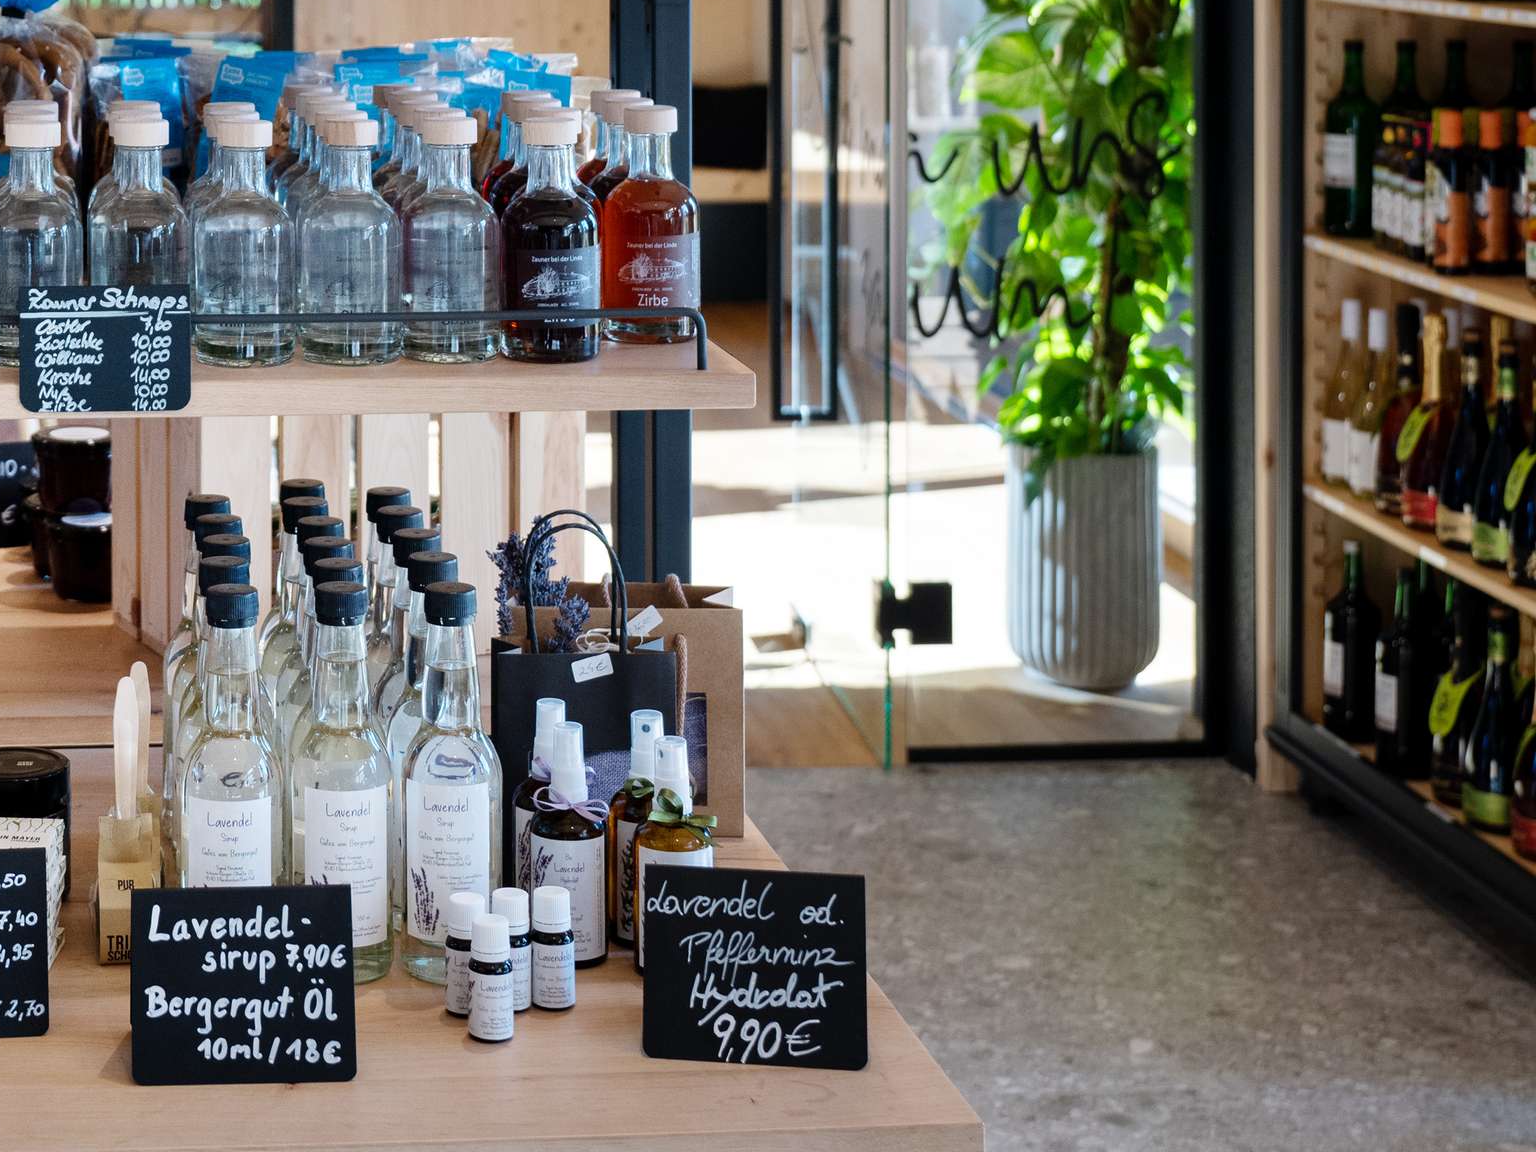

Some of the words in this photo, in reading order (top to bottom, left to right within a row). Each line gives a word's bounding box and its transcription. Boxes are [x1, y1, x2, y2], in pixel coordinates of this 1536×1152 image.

[28, 288, 97, 310] Zauner
[100, 285, 188, 321] Schnaps
[638, 294, 668, 306] Zirbe
[35, 319, 91, 335] Obstler
[140, 316, 172, 335] 7,00
[132, 333, 172, 352] 10,00
[35, 351, 104, 367] Williams
[130, 349, 170, 366] 10,00
[37, 367, 92, 386] Kirsche
[134, 384, 168, 398] 10,00
[38, 399, 92, 412] Zirbe
[326, 800, 371, 817] Lavendel
[423, 796, 468, 813] Lavendel
[207, 812, 253, 828] Lavendel
[554, 863, 585, 873] Lavendel
[117, 879, 135, 891] PUR
[647, 879, 775, 920] Lavendel
[799, 893, 845, 925] od.
[148, 904, 312, 942] Lavendel-
[201, 942, 276, 984] sirup
[679, 929, 855, 985] Pfefferminz
[144, 985, 294, 1037] Bergergut
[303, 977, 338, 1022] Öl
[689, 971, 845, 1026] Hydrolat
[197, 1036, 264, 1061] 10ml
[285, 1038, 342, 1064] 18€
